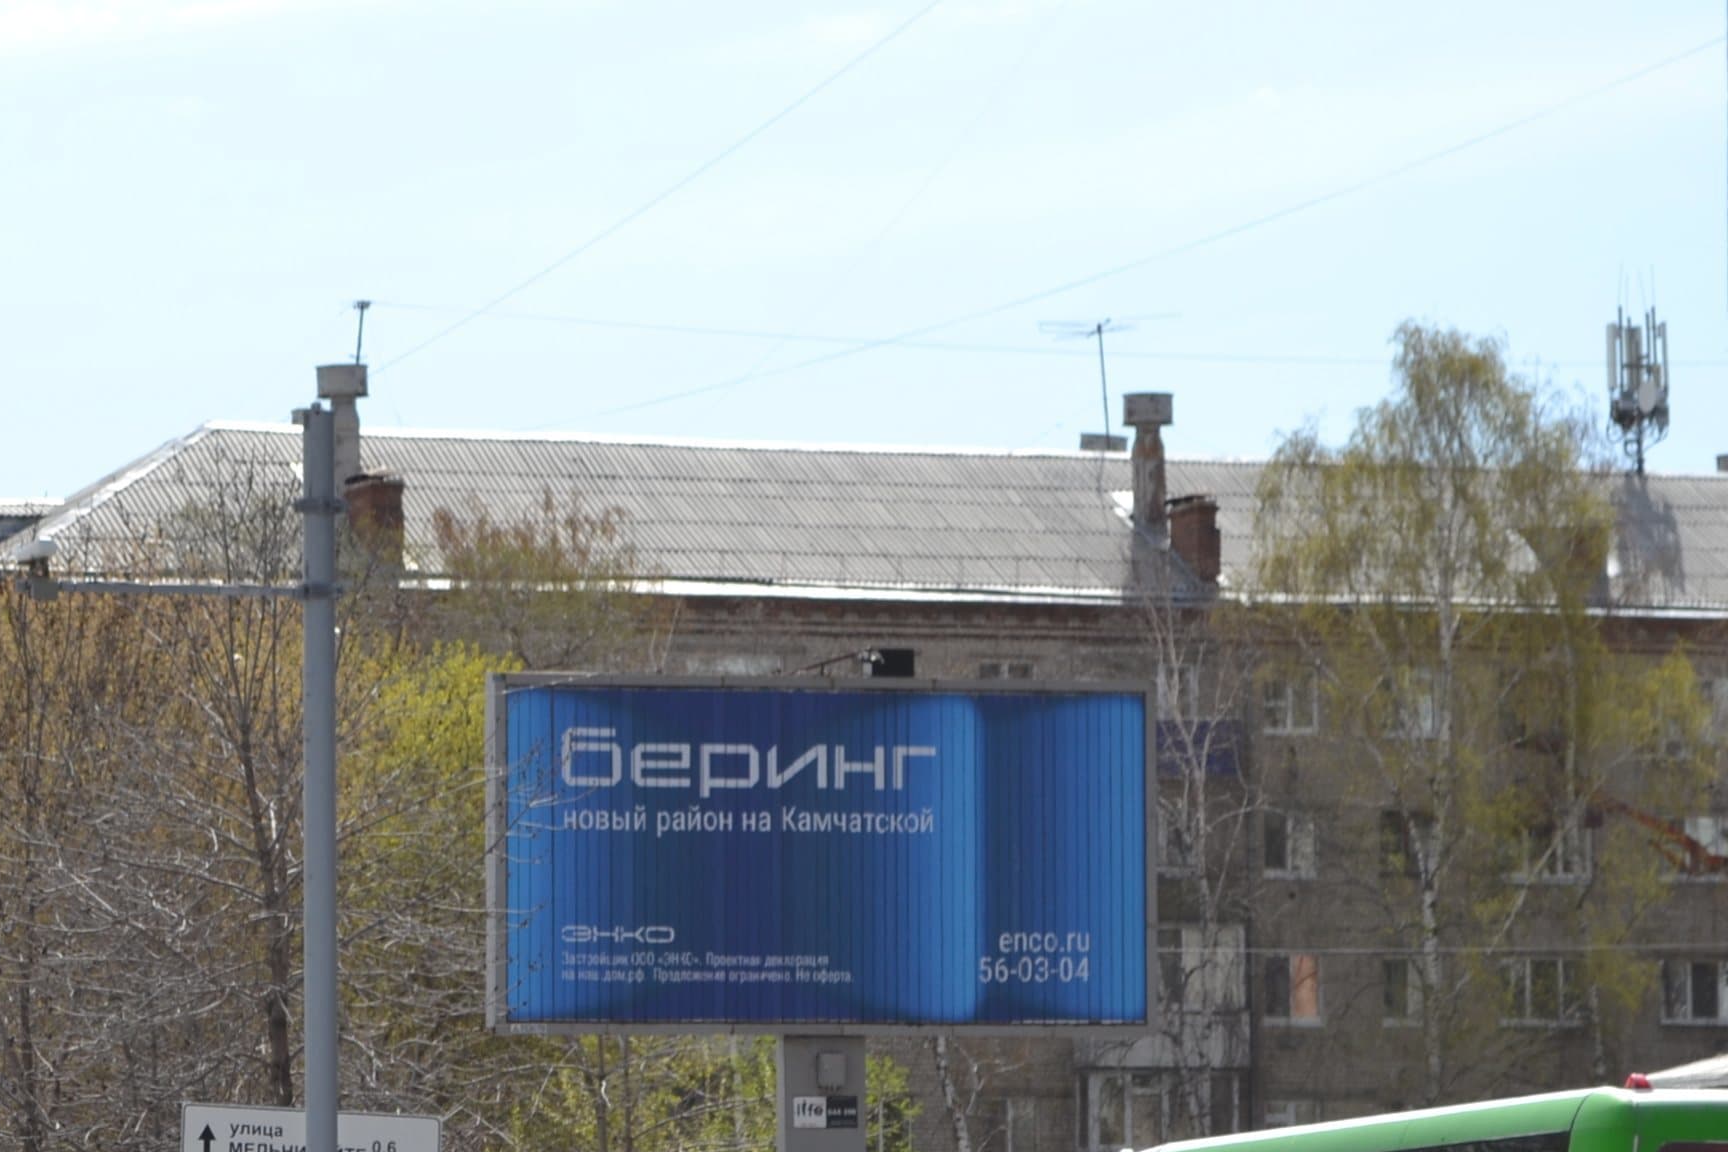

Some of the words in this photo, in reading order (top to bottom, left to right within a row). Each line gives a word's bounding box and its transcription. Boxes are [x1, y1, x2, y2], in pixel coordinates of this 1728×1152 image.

[561, 727, 937, 798] беринг
[564, 804, 647, 831] новый
[656, 805, 732, 838] район
[742, 811, 771, 832] на
[782, 805, 934, 834] Камчатской
[561, 925, 675, 943] ЭНКО
[998, 932, 1090, 952] enco.ru
[979, 956, 1089, 982] 56-03-04
[229, 1123, 283, 1138] улица
